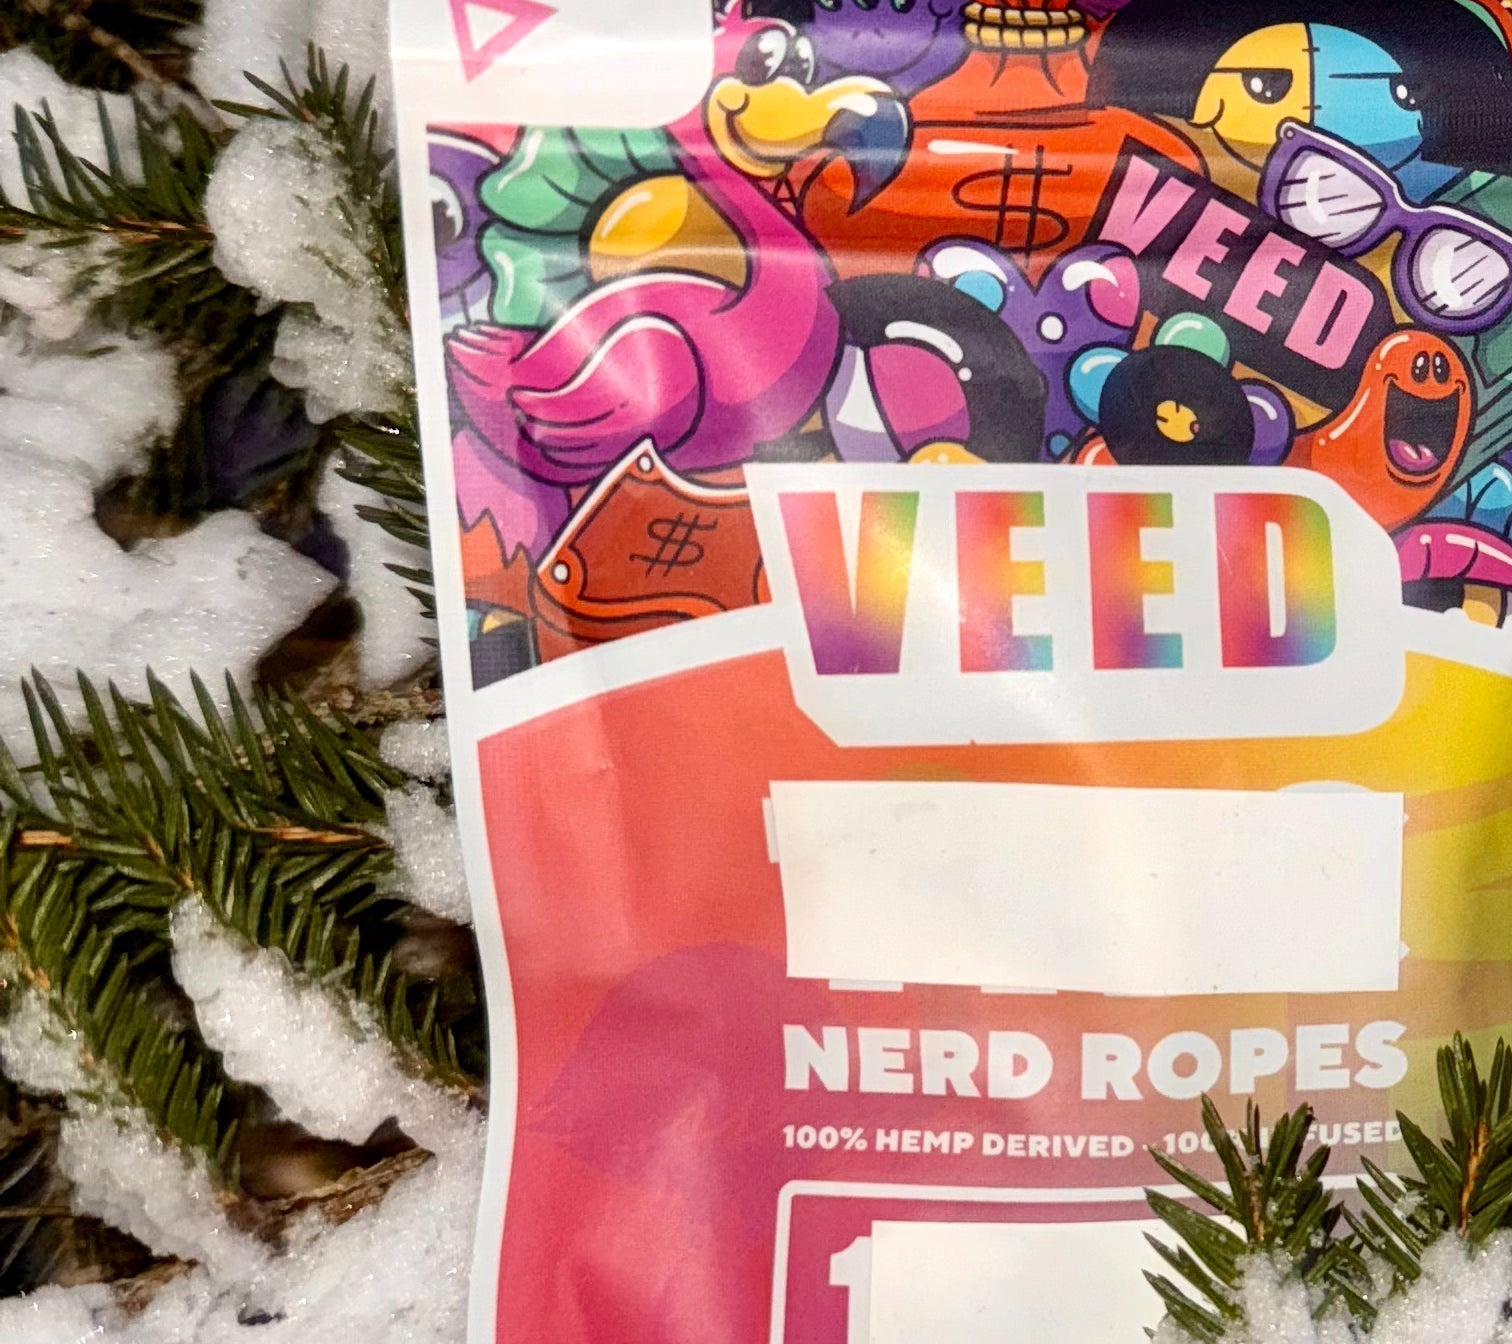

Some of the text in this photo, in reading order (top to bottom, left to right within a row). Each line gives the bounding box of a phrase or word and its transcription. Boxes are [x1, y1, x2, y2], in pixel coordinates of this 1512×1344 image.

[1098, 154, 1375, 370] VEED
[778, 490, 1338, 676] VEED
[782, 1019, 1410, 1101] NERD ROPES
[782, 1124, 867, 1150] 100%
[875, 1128, 975, 1155] HEMP
[981, 1132, 1135, 1158] DERIVED
